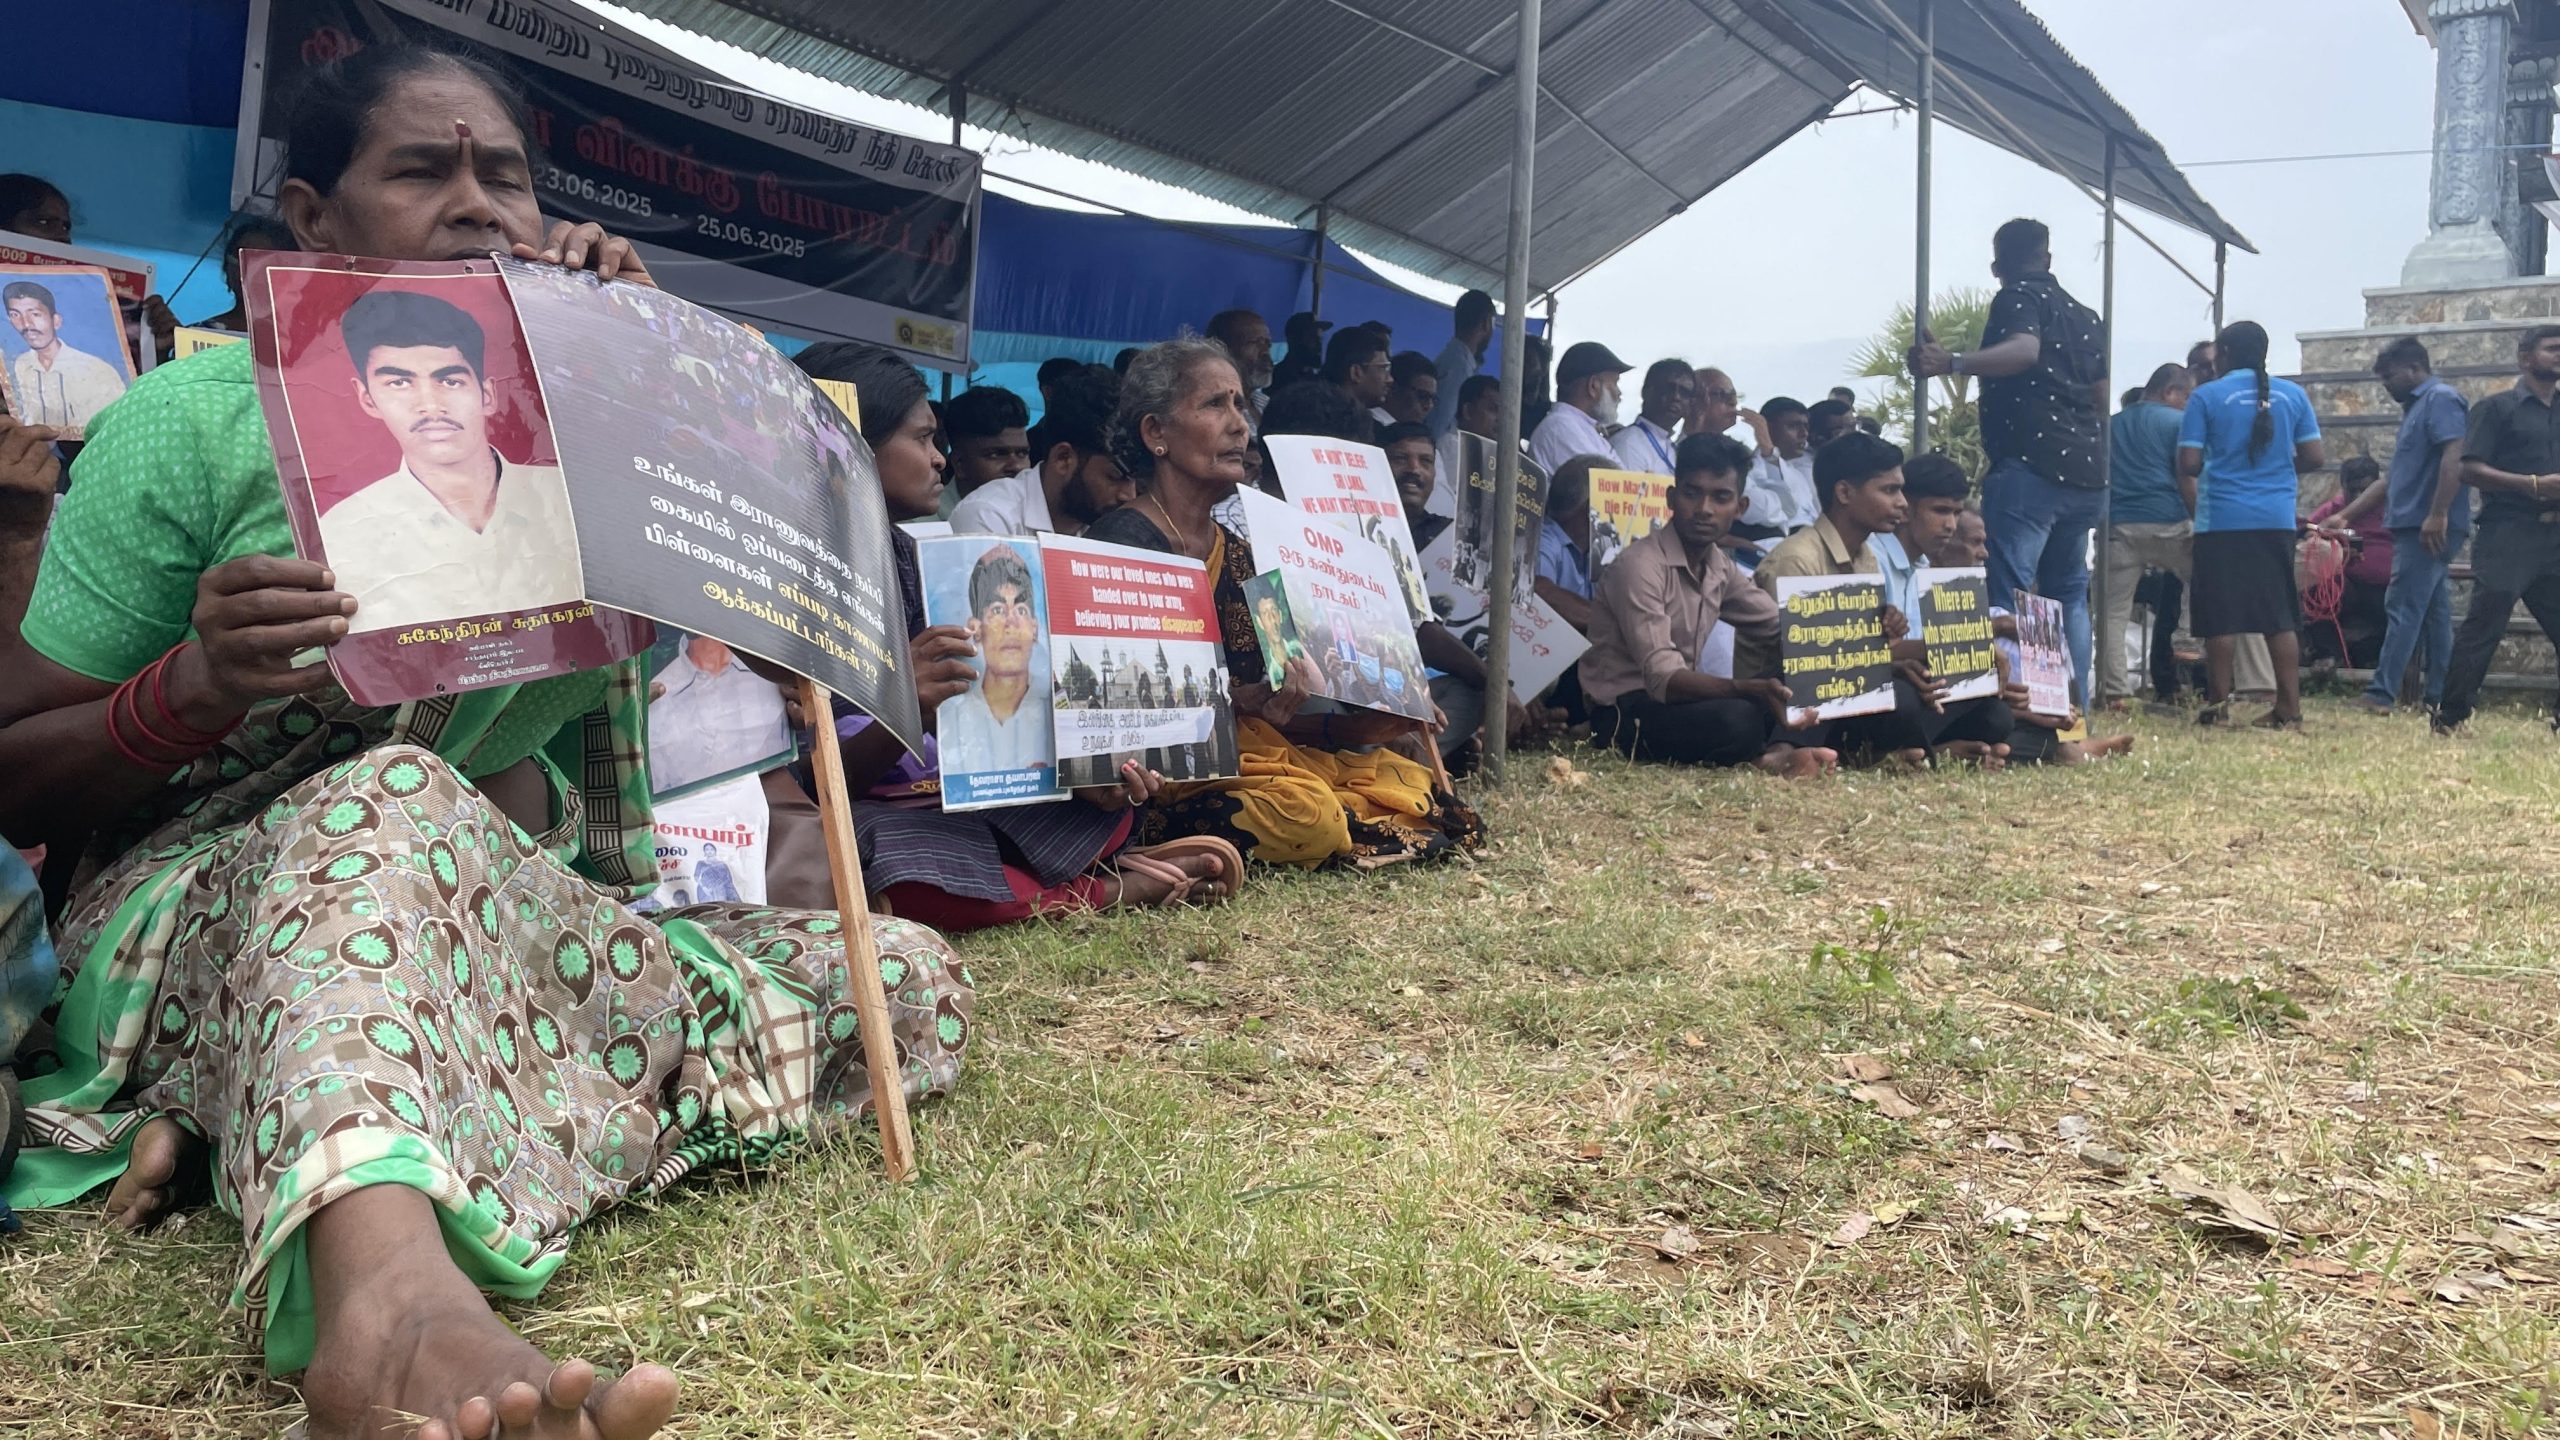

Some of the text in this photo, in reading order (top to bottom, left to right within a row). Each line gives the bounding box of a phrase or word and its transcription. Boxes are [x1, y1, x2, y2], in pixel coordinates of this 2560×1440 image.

[575, 114, 741, 213] விளக்கு
[697, 214, 806, 258] 25.06.2025
[0, 246, 27, 262] 009
[1598, 478, 1620, 493] How
[1623, 480, 1649, 498] May
[1604, 499, 1620, 514] Die
[1641, 503, 1661, 518] Your
[633, 456, 885, 608] உங்கள் இராணுவத்தை நம்பி
[1304, 526, 1344, 557] OMP
[650, 495, 886, 636] கையில் ஒப்படைத்த எங்கள்
[1071, 559, 1194, 589] How were our loved ones who were
[1278, 545, 1386, 600] ஒரு கண்துடைப்பு
[645, 524, 897, 672] பிள்ளைகள் எப்படி காணாமல்
[1092, 586, 1122, 605] handed
[1121, 590, 1139, 606] over
[1139, 591, 1148, 607] to
[1148, 595, 1164, 609] your
[1311, 582, 1360, 609] நாடகம்
[1787, 587, 1879, 618] இறுதிப் போரில்
[1932, 584, 1975, 613] Where are
[397, 602, 595, 645] சுகேந்திரன் சுதாகரன்
[703, 581, 860, 668] ஆக்கப்பட்டார்கள்
[1075, 609, 1112, 630] believing
[1112, 614, 1130, 630] your
[1131, 614, 1161, 632] promise
[1923, 615, 1994, 645] who surrendered to
[1782, 643, 1892, 676] சரணடைந்தவர்கள்
[1927, 648, 1941, 678] Sri
[1940, 646, 1970, 676] Lankan
[1971, 642, 1995, 671] Army?
[1815, 676, 1855, 699] எங்கே
